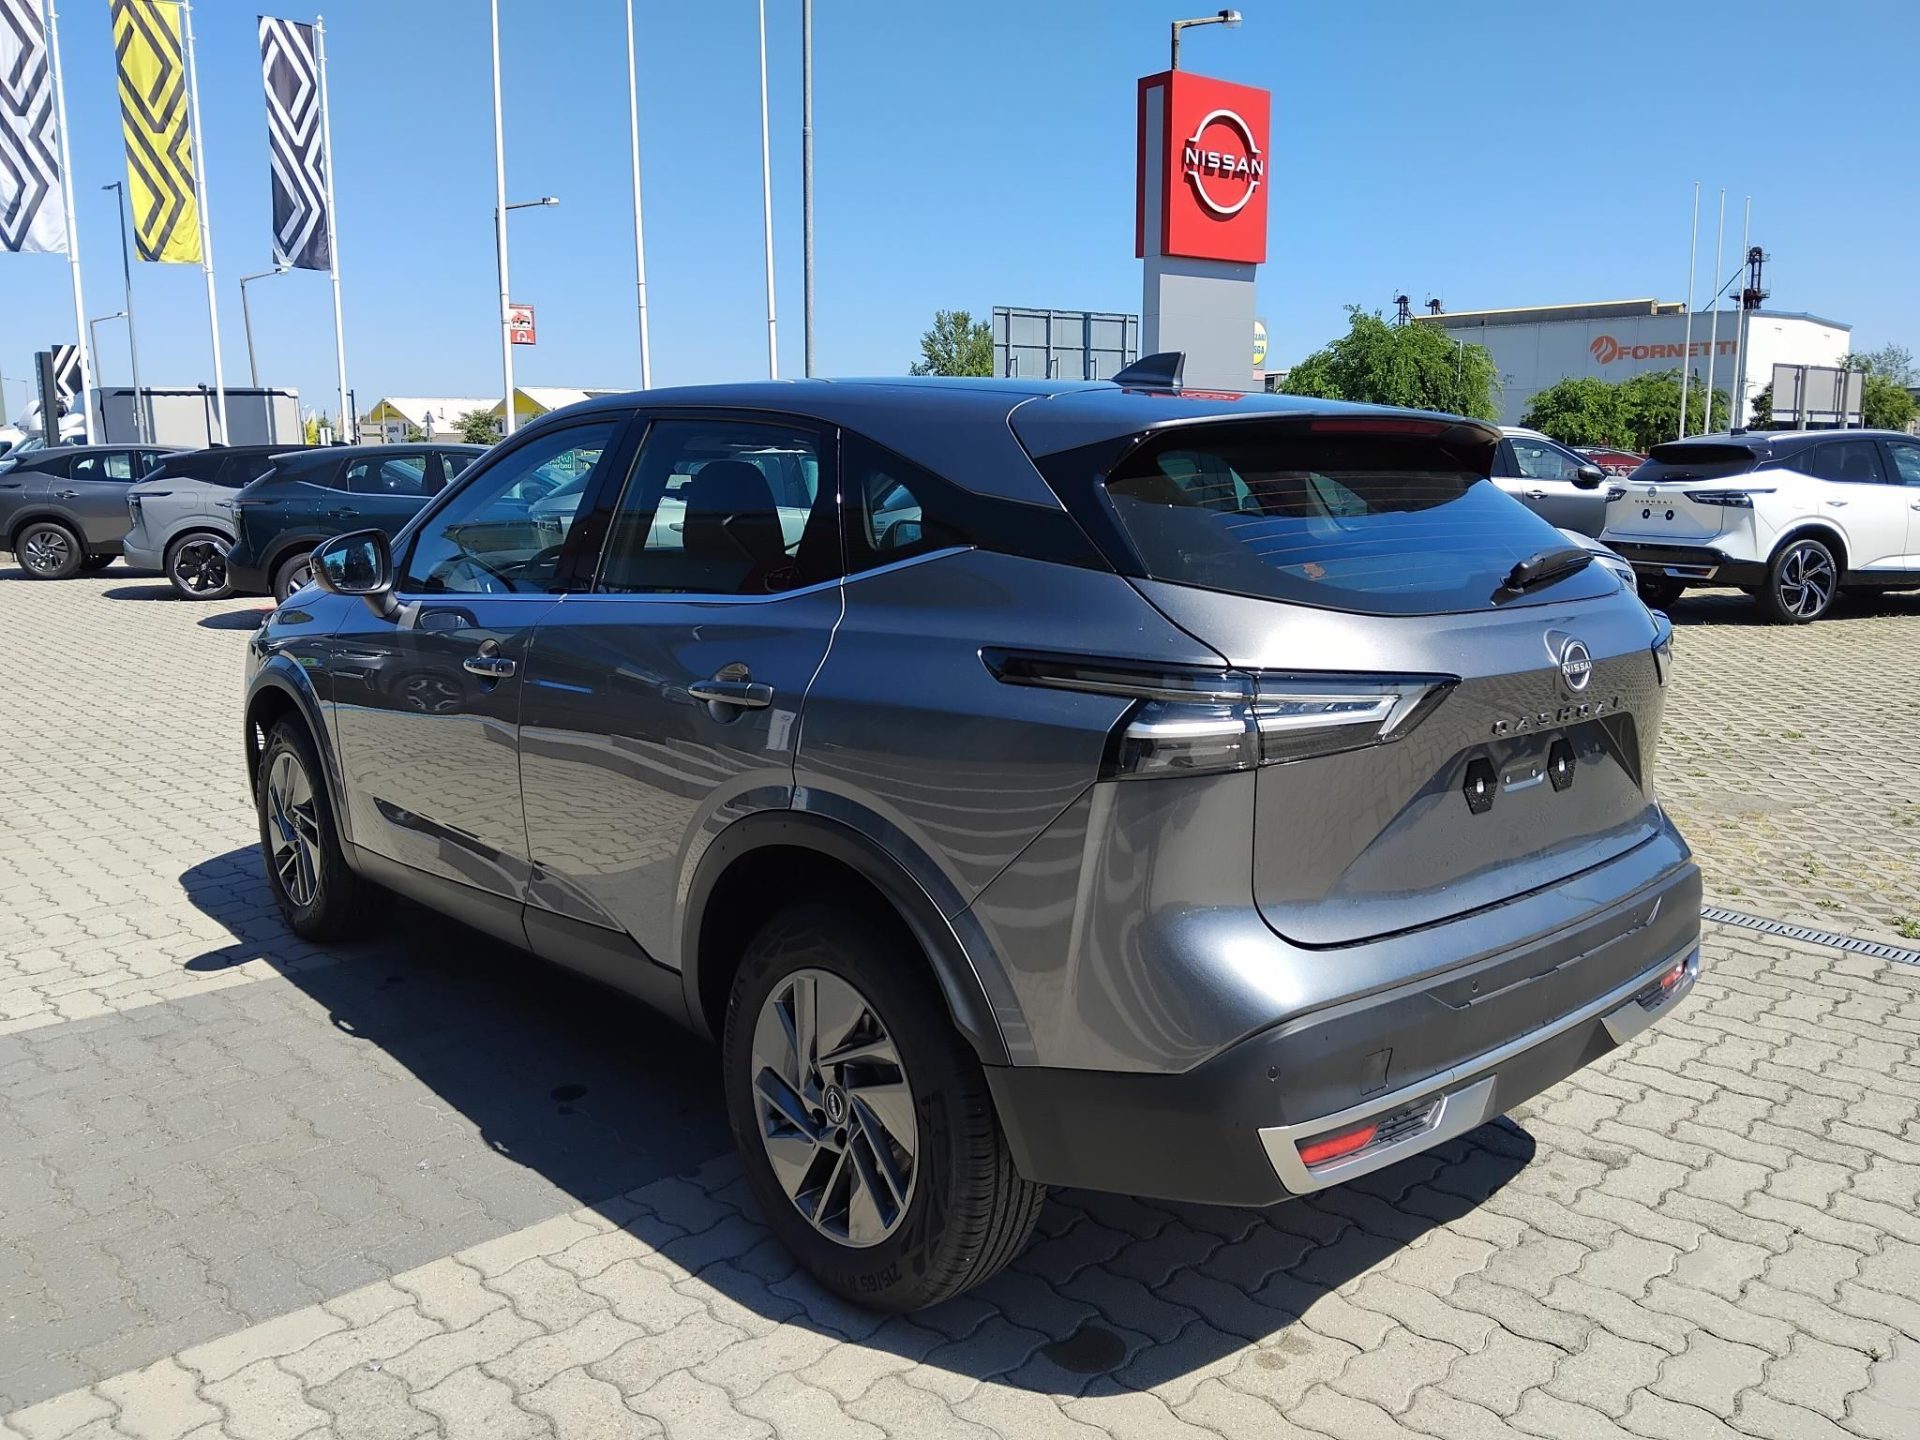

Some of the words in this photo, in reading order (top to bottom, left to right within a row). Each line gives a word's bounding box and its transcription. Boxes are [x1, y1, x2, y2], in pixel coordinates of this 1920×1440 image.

[1184, 146, 1265, 177] NISSAN
[1616, 340, 1738, 360] FORNETTI
[1491, 696, 1620, 737] QASHQAI
